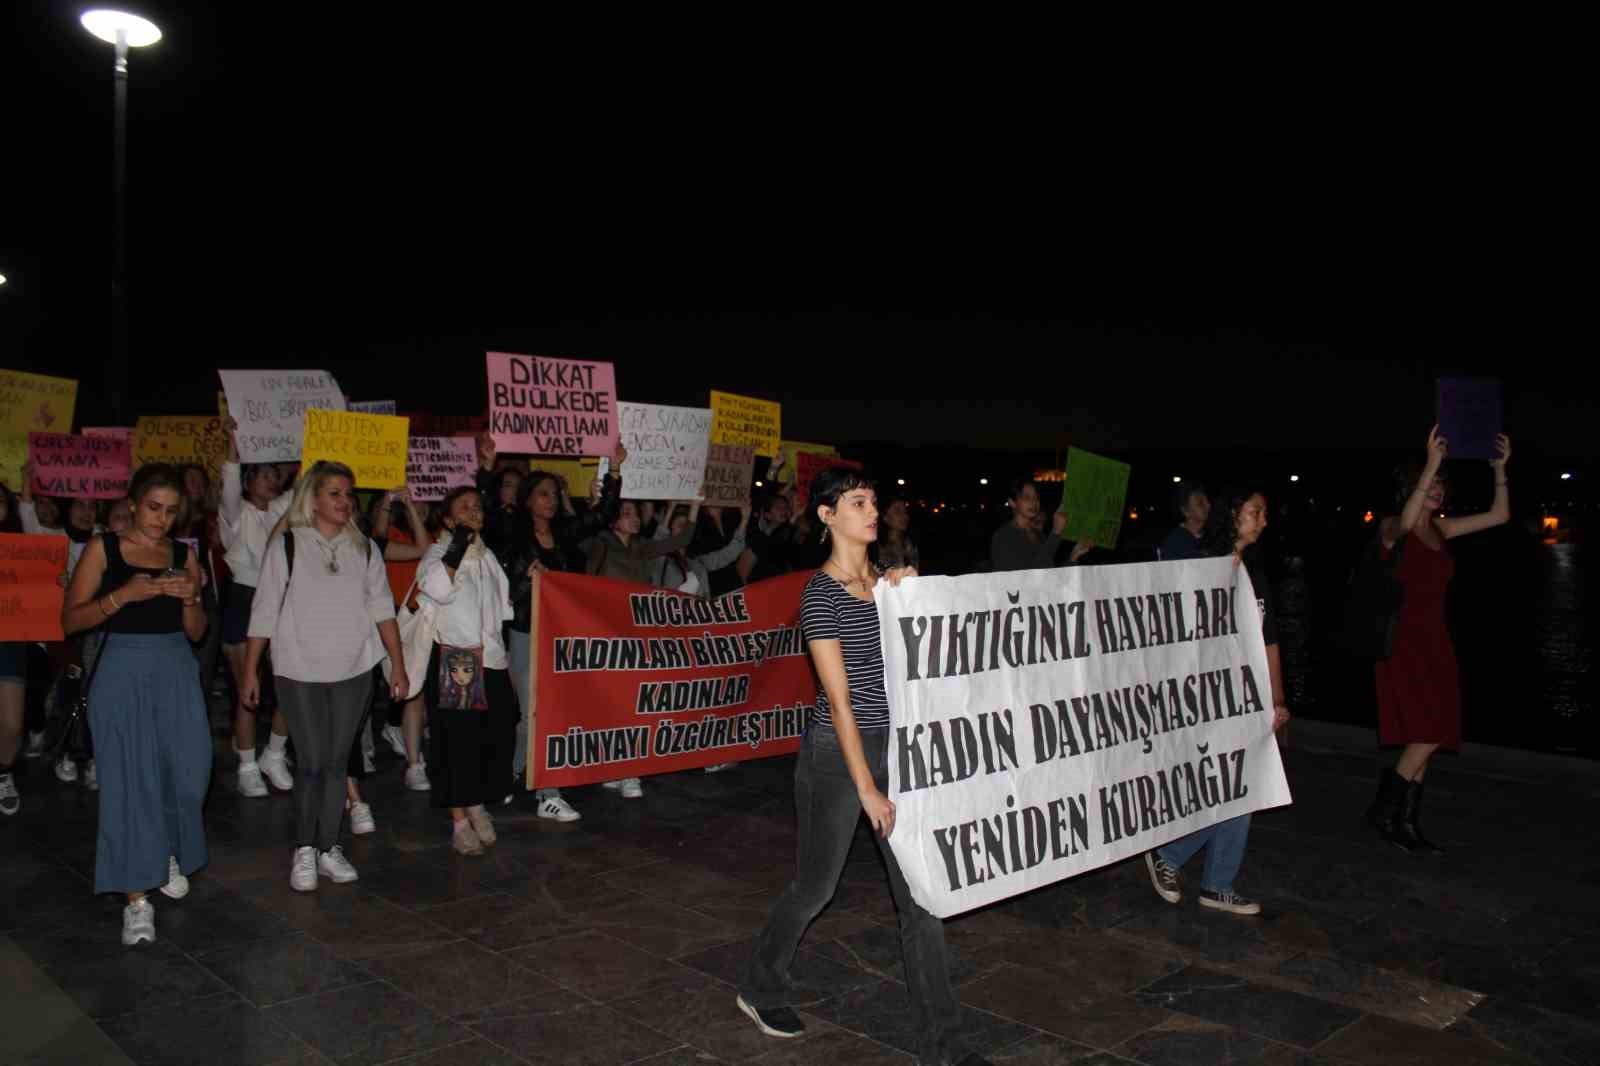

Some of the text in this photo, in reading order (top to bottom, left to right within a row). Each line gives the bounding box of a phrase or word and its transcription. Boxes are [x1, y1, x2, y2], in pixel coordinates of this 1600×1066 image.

[510, 357, 596, 390] DİKKAT
[534, 436, 584, 454] VAR!
[34, 476, 90, 494] WALK
[630, 592, 750, 627] MÜCADELE
[899, 586, 1238, 680] YIKTIĞINIZ HAYATLARI
[553, 636, 690, 673] KADINLARI
[637, 674, 751, 714] KADINLAR
[546, 726, 649, 770] DÜNYAYI
[897, 665, 1264, 793] KADIN DAYANIŞMASIYLA
[934, 741, 1248, 892] YENİDEN KURACAĞIZ
